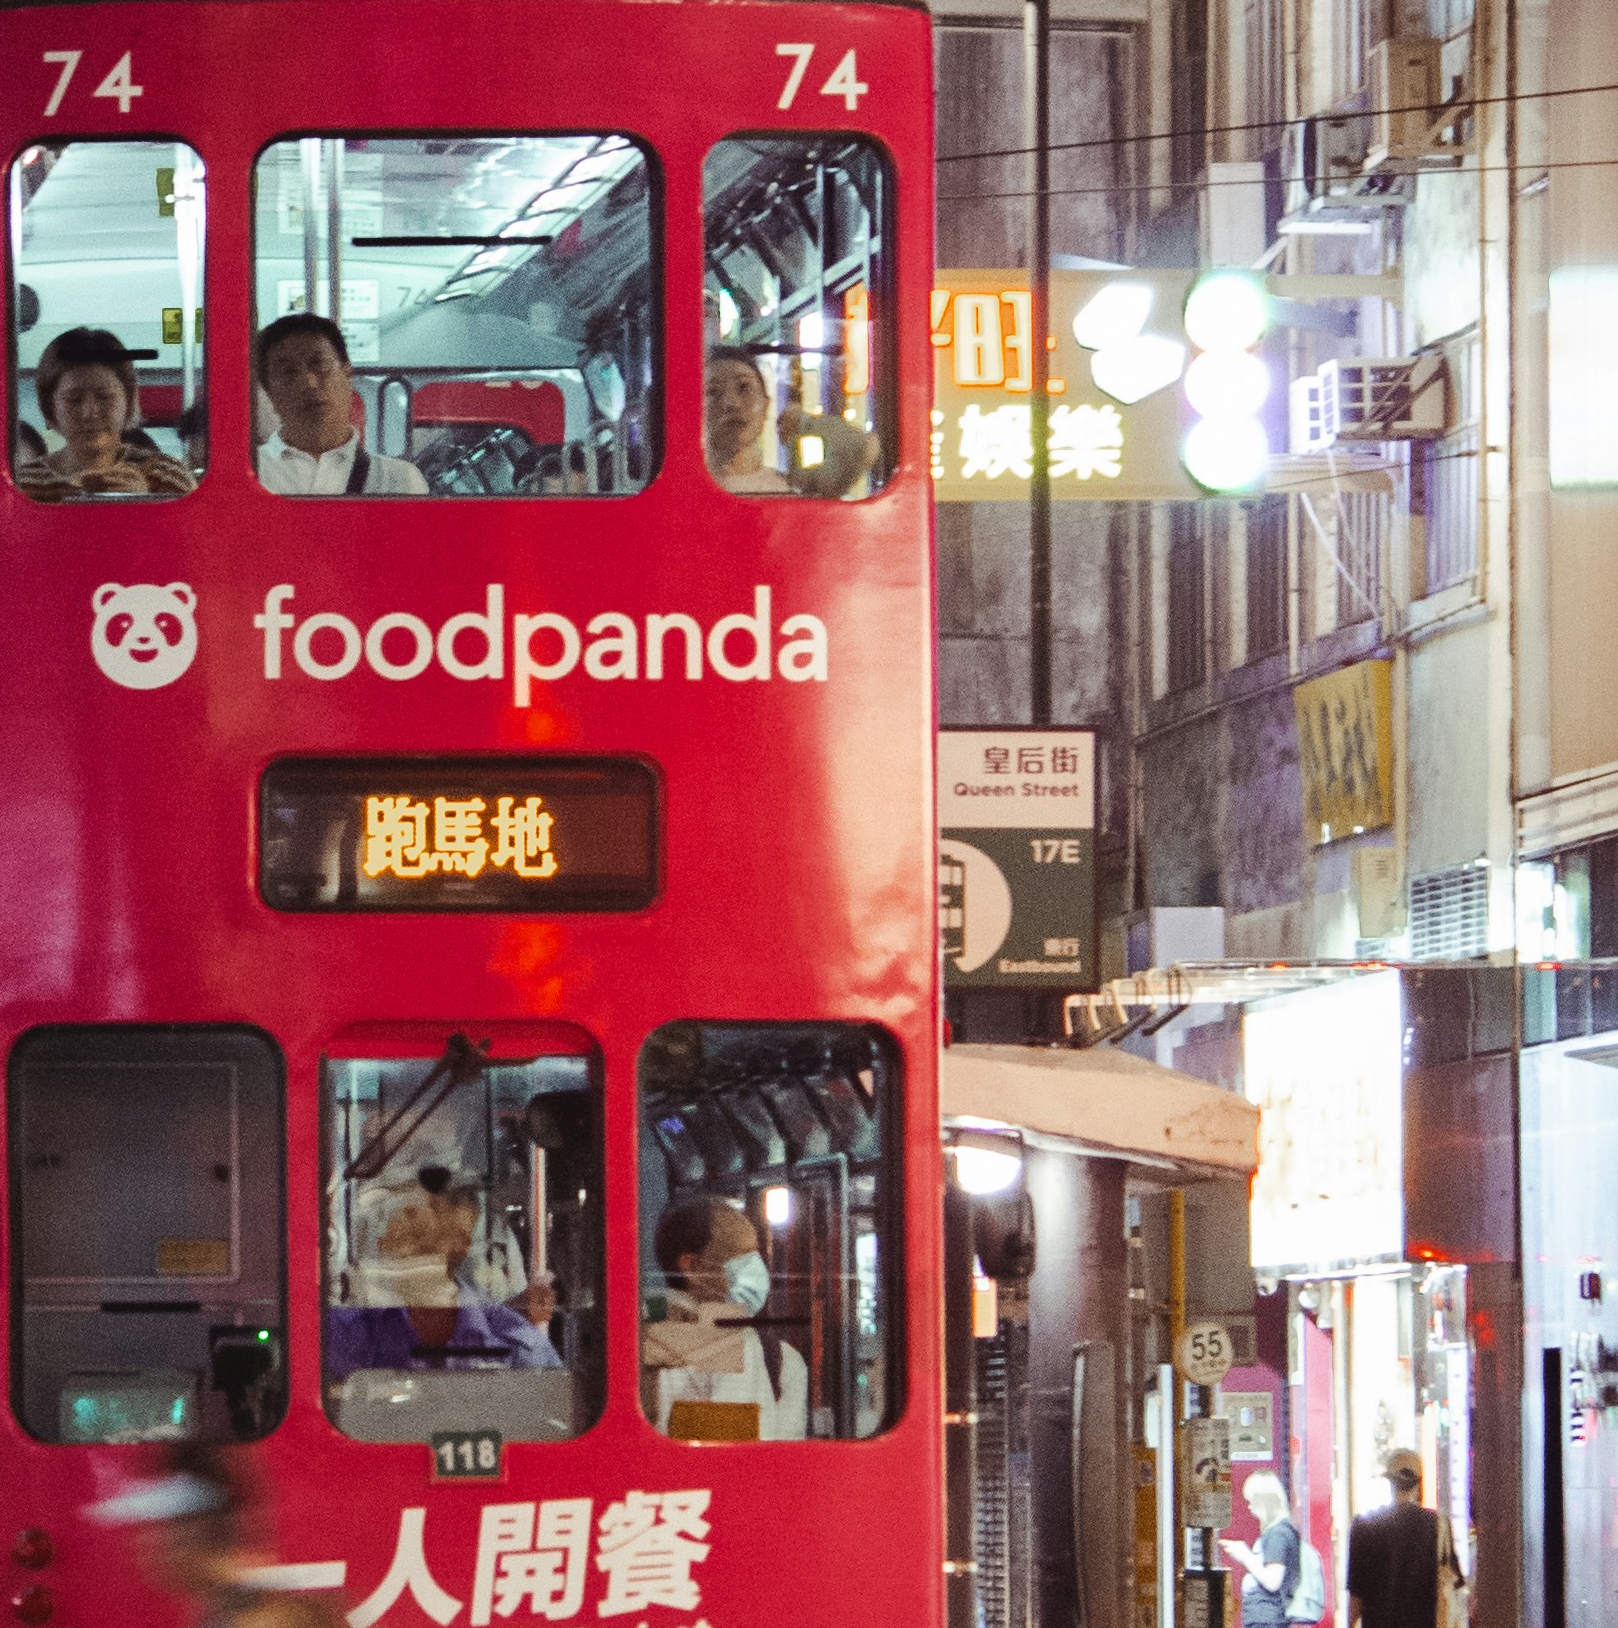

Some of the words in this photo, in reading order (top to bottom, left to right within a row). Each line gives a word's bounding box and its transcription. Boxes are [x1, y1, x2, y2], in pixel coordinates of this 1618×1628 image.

[42, 49, 144, 117] 74
[775, 42, 869, 112] 74
[931, 404, 1124, 480] 娛樂
[253, 583, 829, 708] foodpanda
[984, 746, 1079, 774] 皇后街
[954, 782, 1015, 797] Queen
[1021, 782, 1080, 797] Street
[363, 796, 557, 879] 跑馬地
[1030, 839, 1081, 864] 17E
[1192, 1330, 1222, 1361] 55
[438, 1438, 498, 1472] 118
